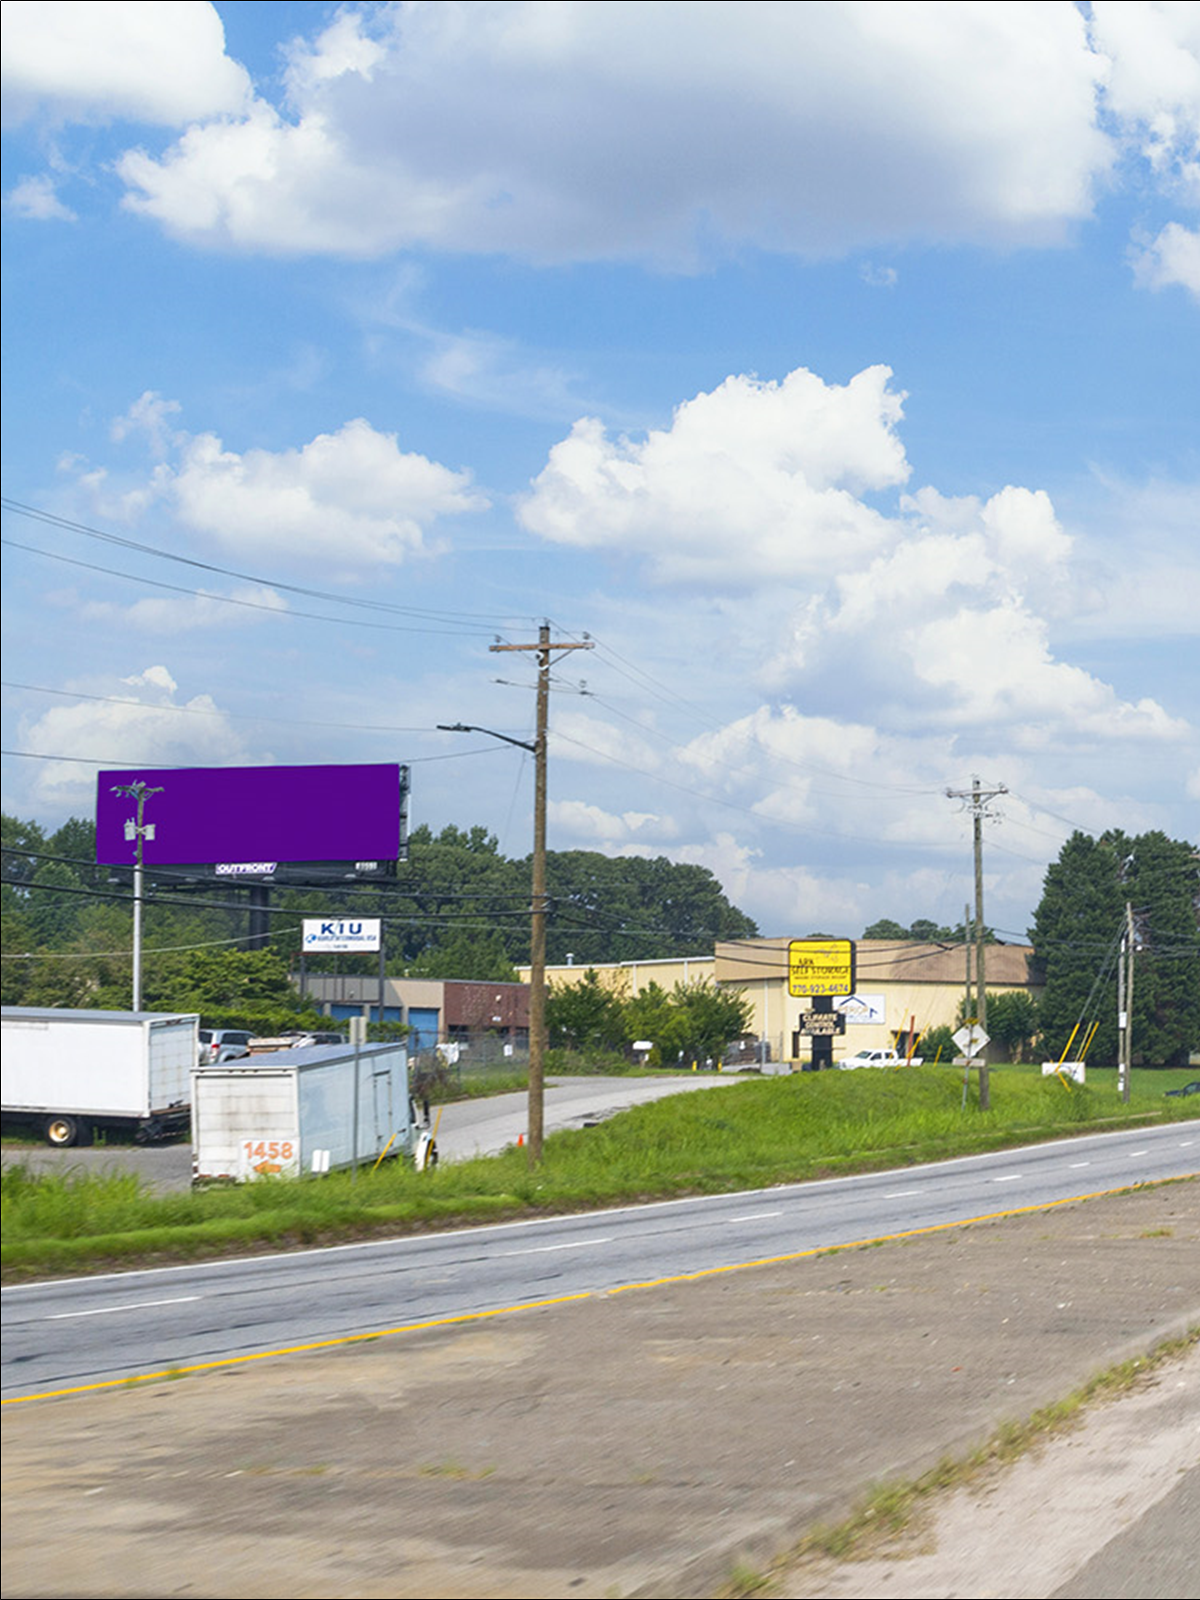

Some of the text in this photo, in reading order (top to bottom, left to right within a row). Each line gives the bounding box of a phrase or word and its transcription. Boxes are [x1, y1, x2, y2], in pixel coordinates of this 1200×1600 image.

[217, 863, 275, 874] OUTFRONT
[321, 923, 362, 934] KIU
[244, 1141, 293, 1160] 1458
